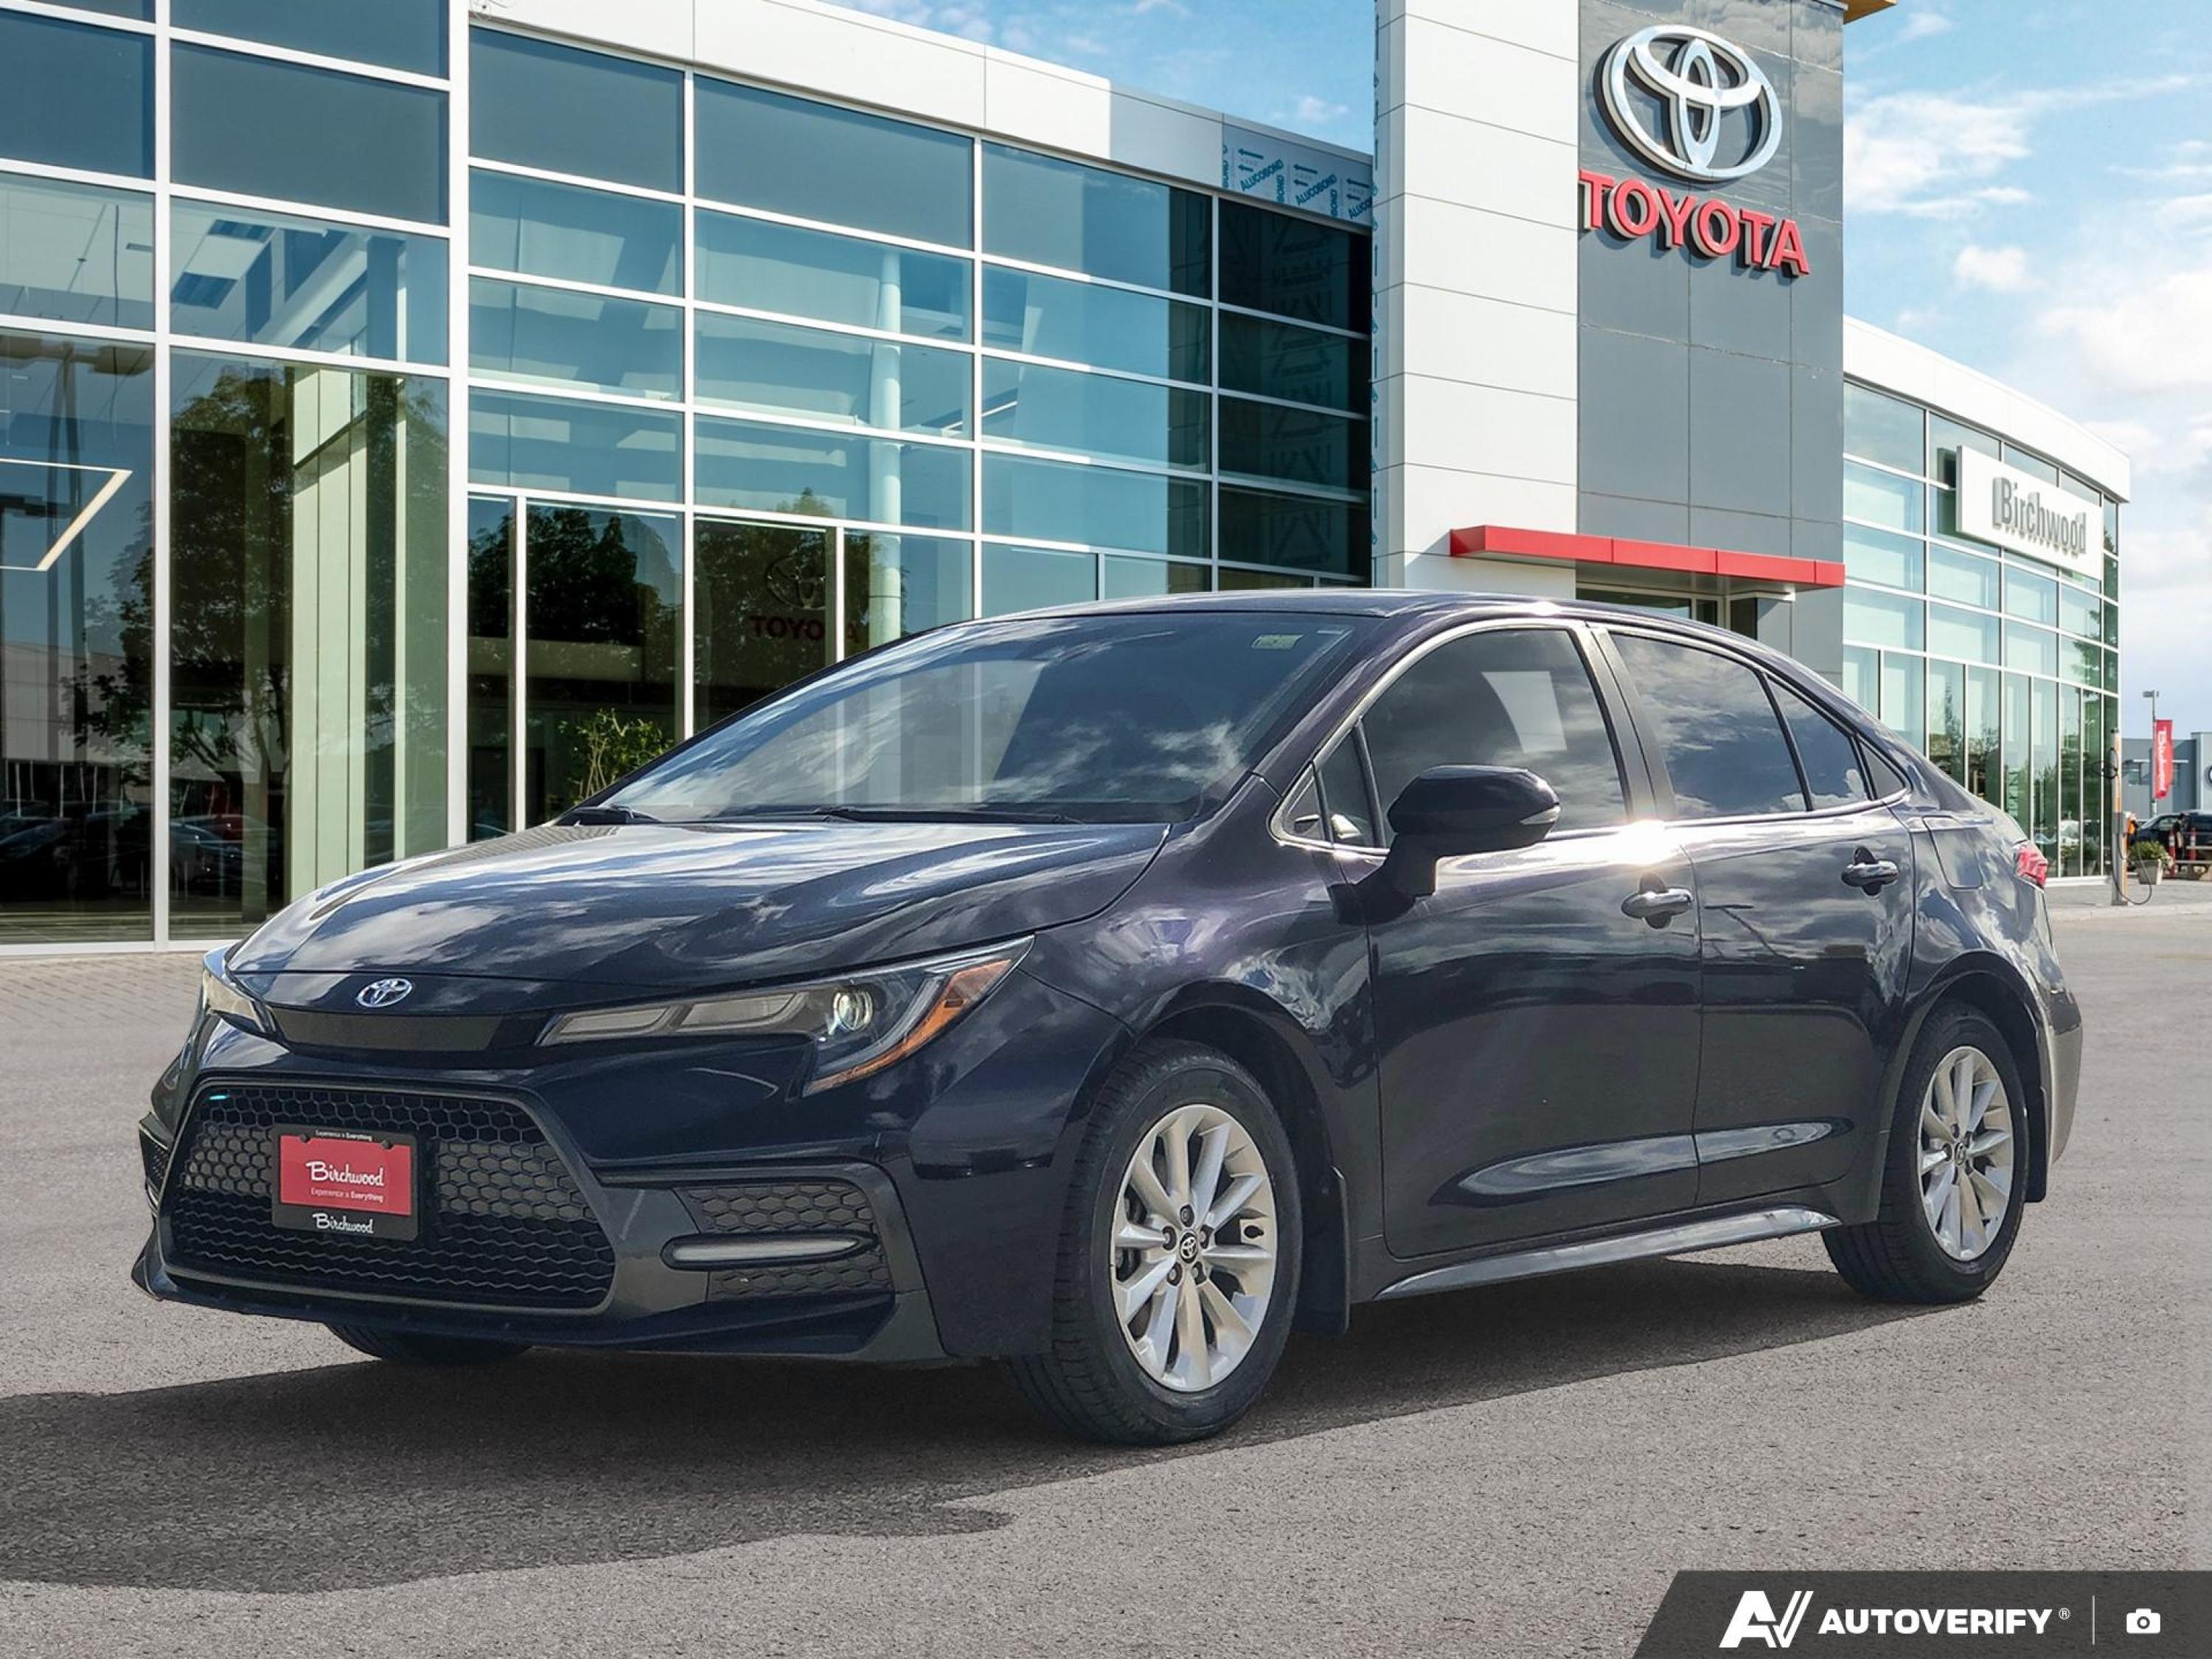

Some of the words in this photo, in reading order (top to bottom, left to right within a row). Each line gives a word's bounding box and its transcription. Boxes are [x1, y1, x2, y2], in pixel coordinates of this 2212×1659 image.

[1240, 159, 1284, 191] ALUCOBOND
[1295, 173, 1338, 206] ALUCOBOND
[1579, 169, 1809, 275] TOYOTA
[1995, 476, 2087, 555] Birchwood
[748, 615, 861, 644] TOYOA
[306, 1161, 385, 1186] Birchwood
[313, 1213, 374, 1234] Birchwood
